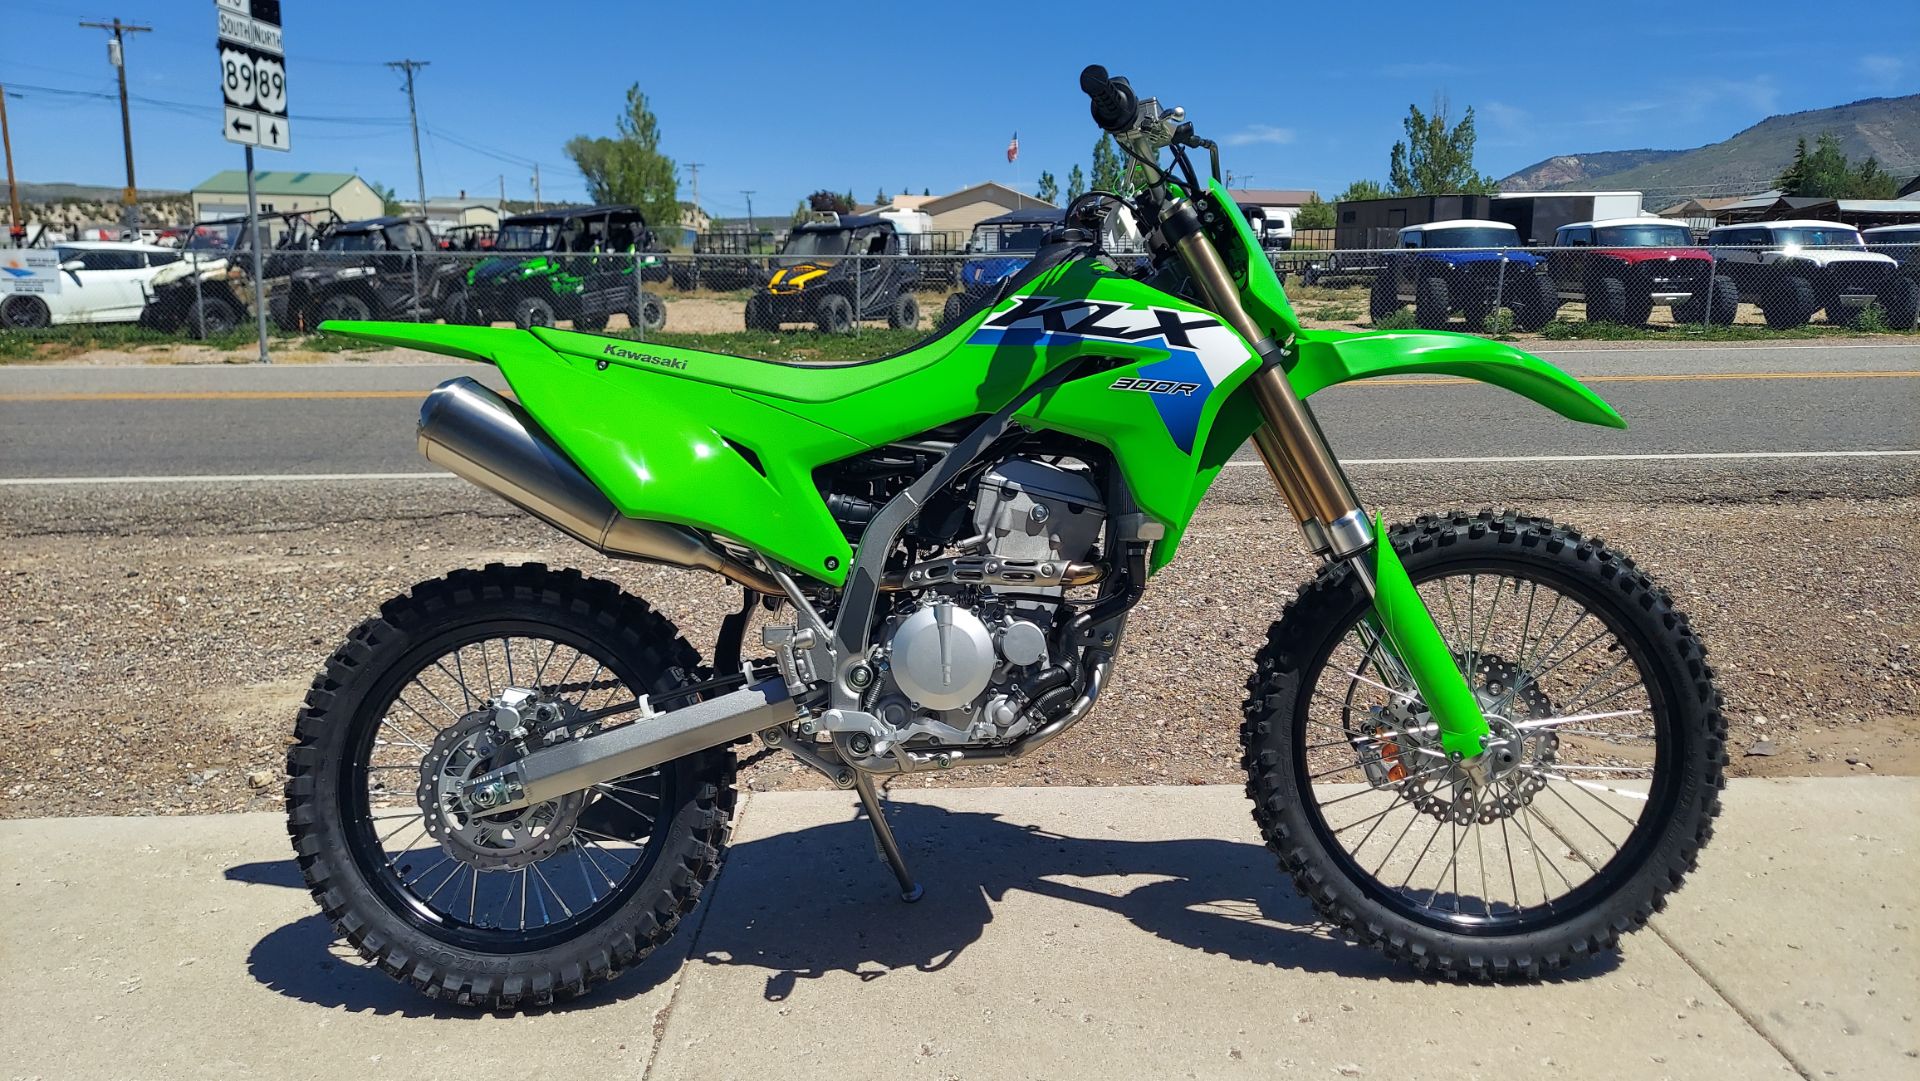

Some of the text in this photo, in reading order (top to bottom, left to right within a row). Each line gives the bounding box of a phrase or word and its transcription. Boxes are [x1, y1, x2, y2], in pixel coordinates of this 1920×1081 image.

[221, 14, 251, 41] SOUTH
[254, 24, 284, 50] NORTH
[226, 60, 252, 92] 89
[259, 70, 283, 100] 89
[983, 297, 1223, 350] KLX
[603, 344, 688, 370] Kawasaki
[1108, 377, 1200, 396] 300R
